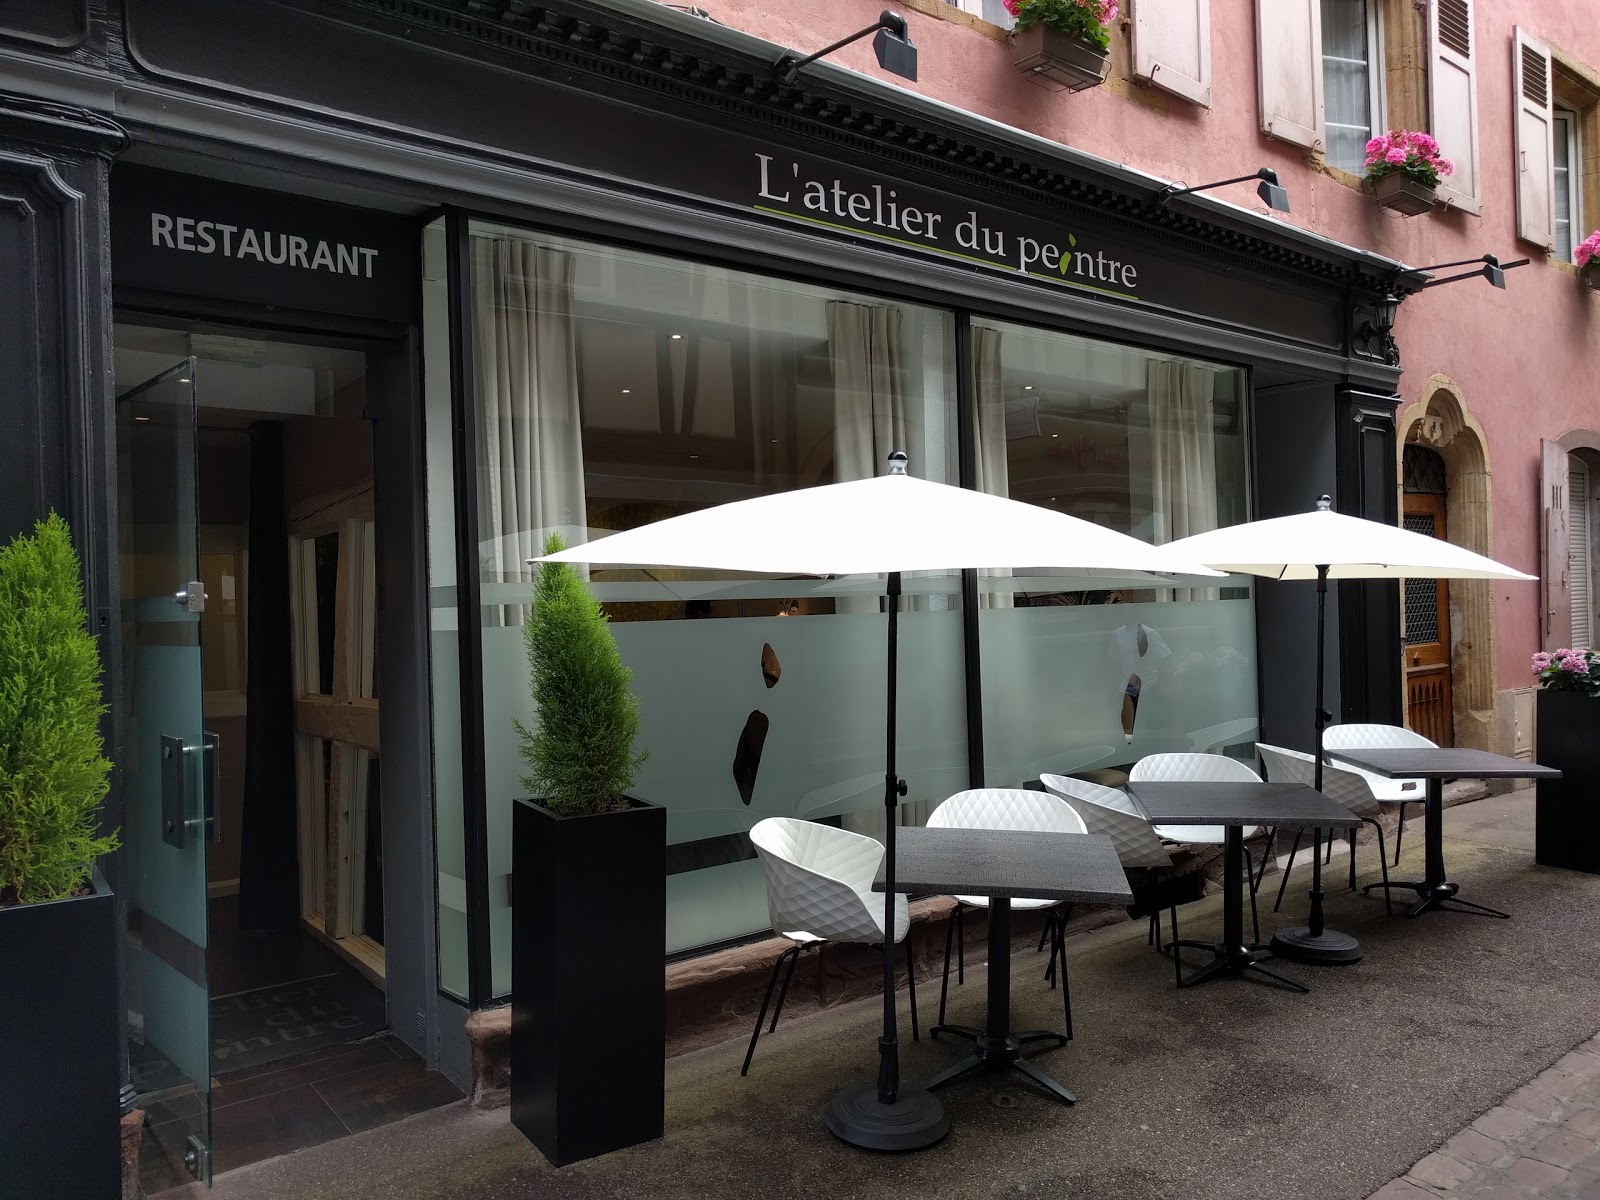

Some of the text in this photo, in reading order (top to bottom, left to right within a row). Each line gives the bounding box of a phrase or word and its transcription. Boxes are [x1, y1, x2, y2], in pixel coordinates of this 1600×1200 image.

[151, 212, 379, 279] RESTAURANT
[753, 152, 1138, 289] L'atelier du peintre
